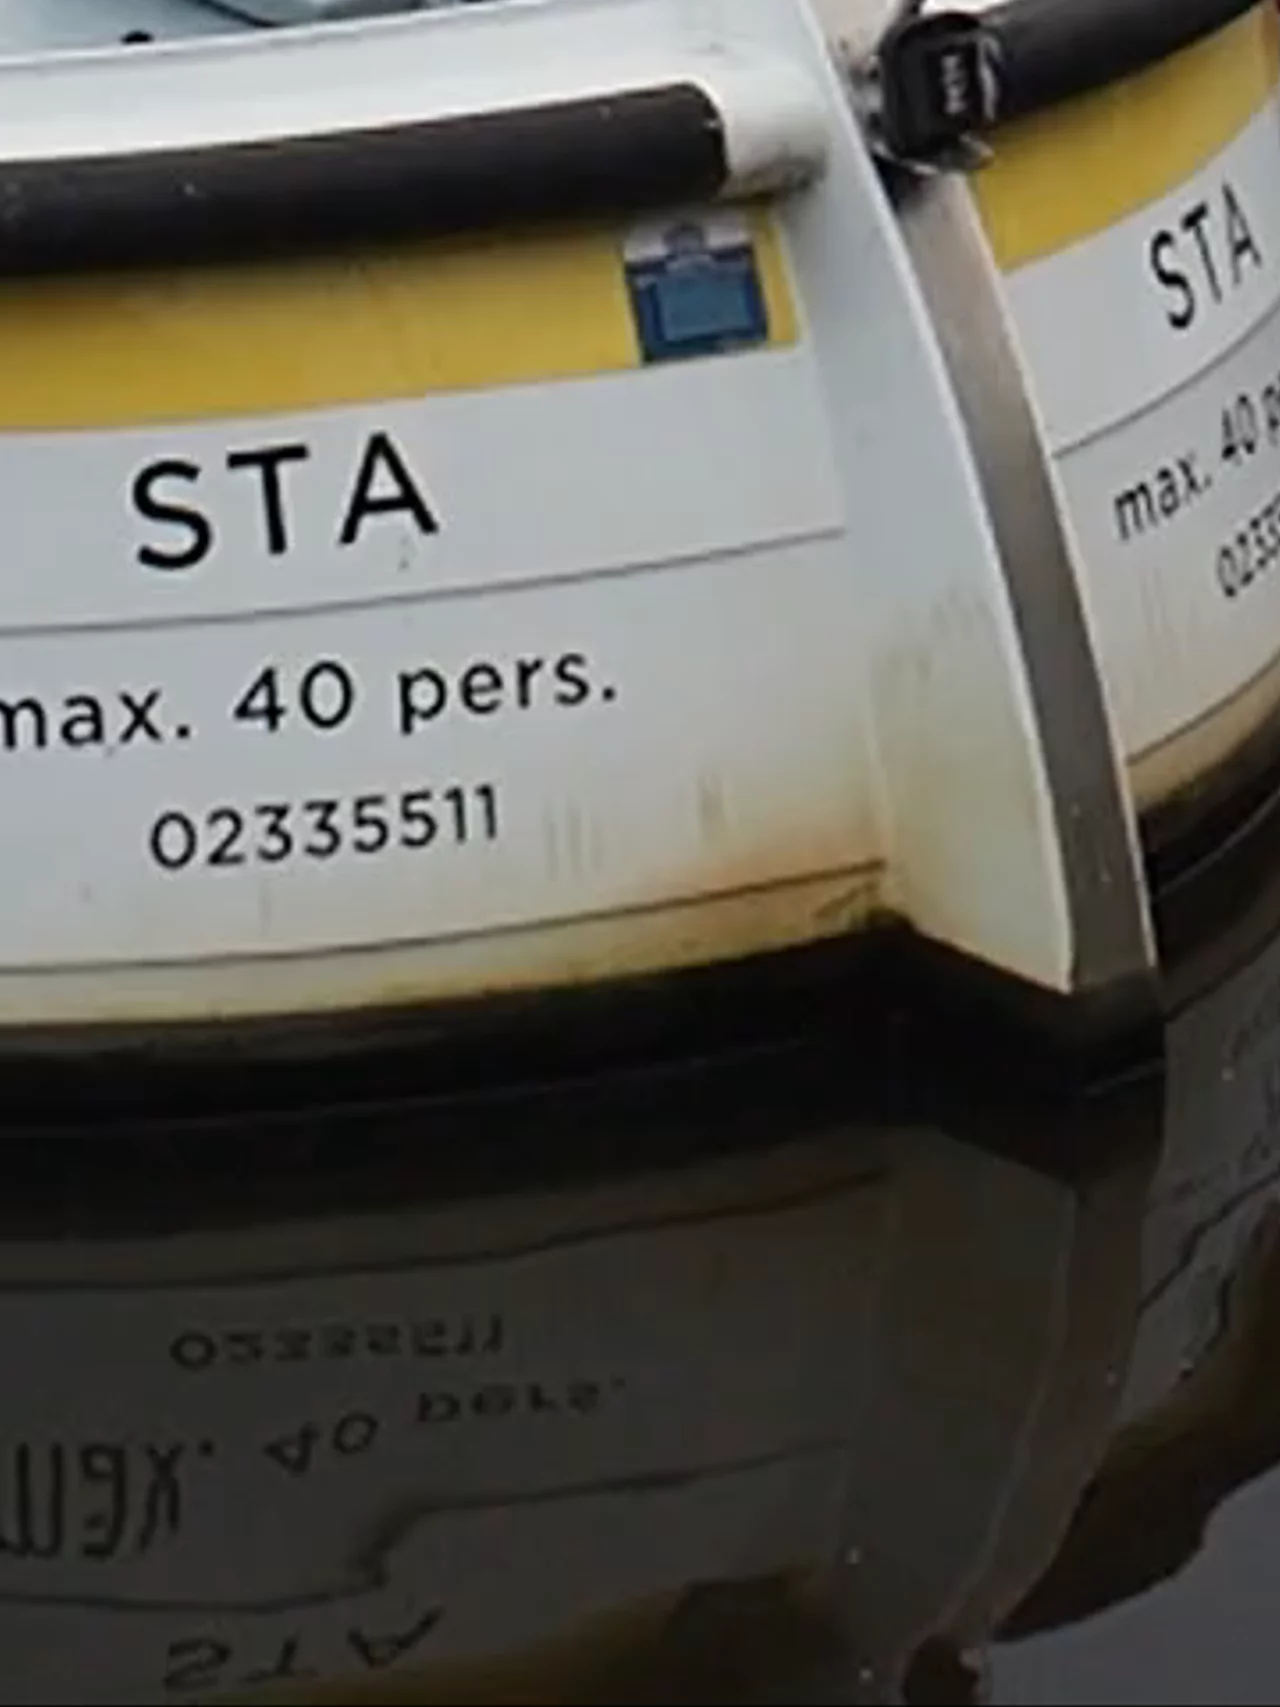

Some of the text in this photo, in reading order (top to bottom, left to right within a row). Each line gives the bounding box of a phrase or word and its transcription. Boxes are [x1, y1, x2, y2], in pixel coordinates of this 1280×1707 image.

[1149, 182, 1263, 331] STA
[131, 431, 439, 571] STA
[1114, 450, 1213, 541] max.
[1221, 393, 1257, 464] 40
[233, 659, 355, 733] 40
[397, 652, 617, 736] pers.
[150, 783, 498, 870] 02335511
